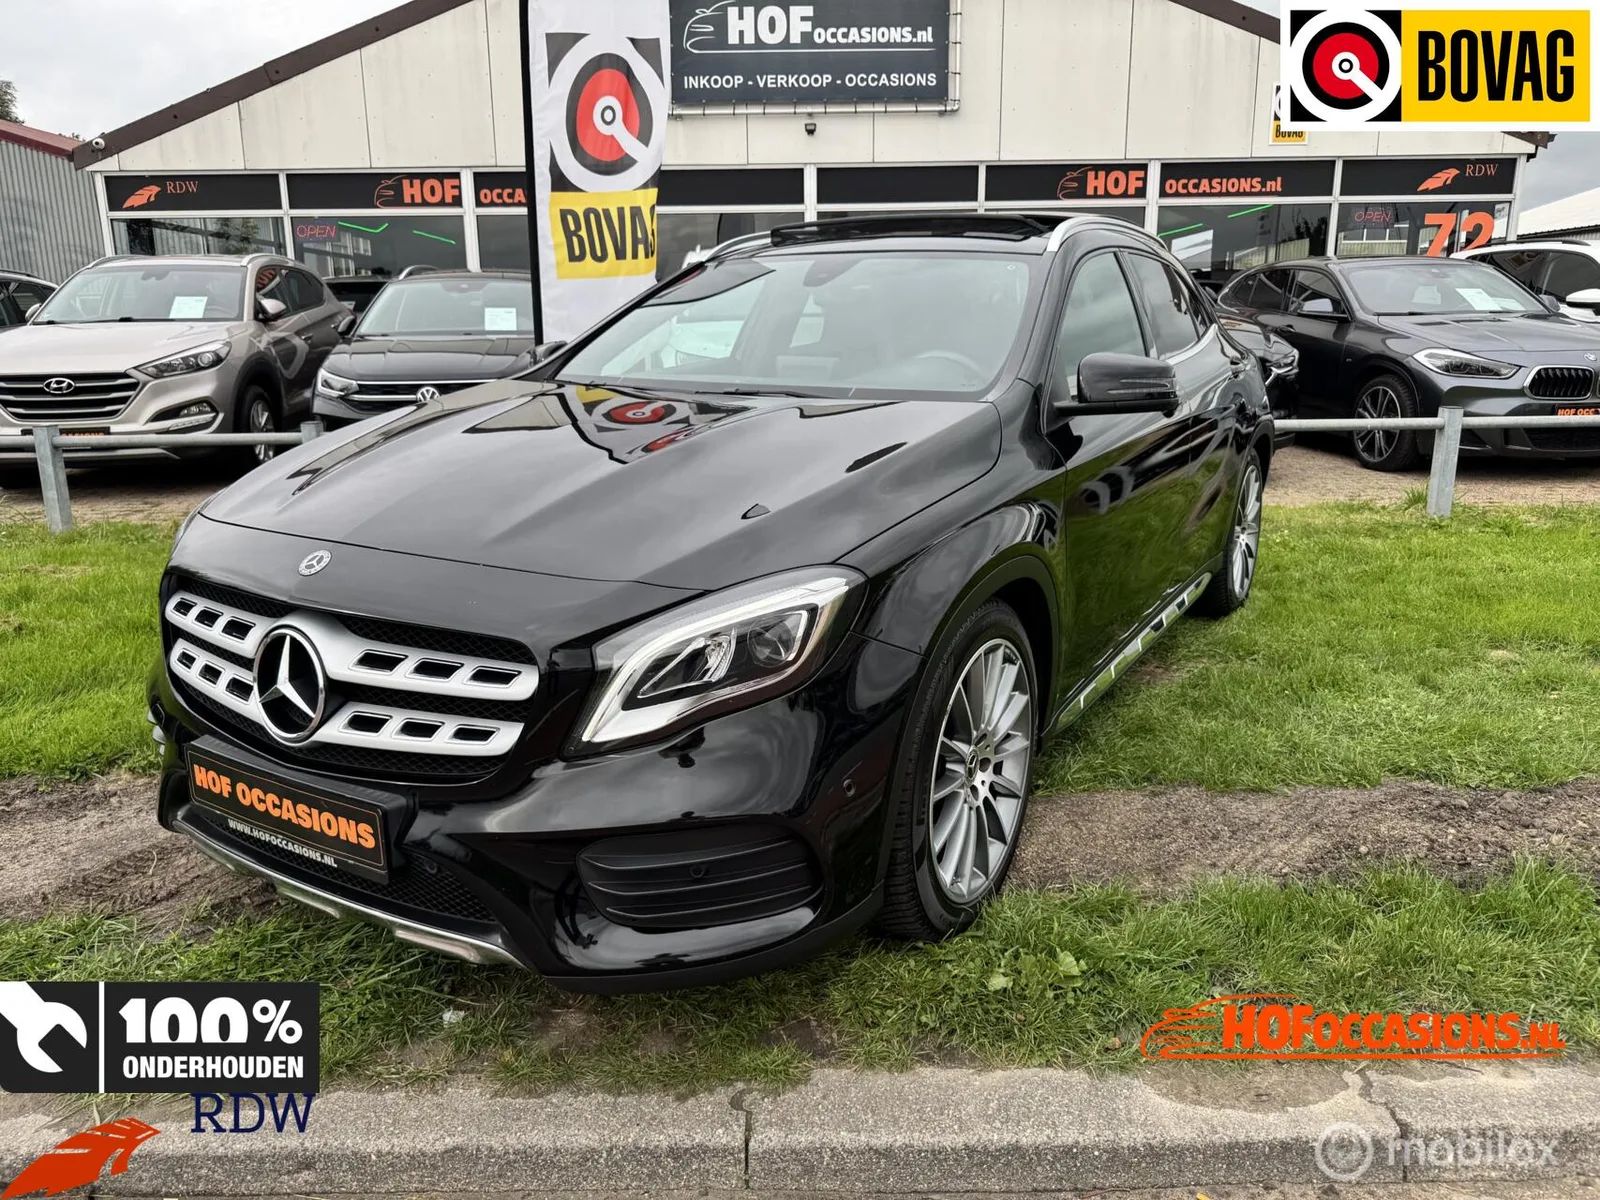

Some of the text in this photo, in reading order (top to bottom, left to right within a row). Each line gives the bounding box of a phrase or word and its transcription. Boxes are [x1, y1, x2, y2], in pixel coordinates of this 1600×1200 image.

[684, 75, 744, 90] INKOOP
[756, 74, 833, 89] VERKOOP
[844, 72, 937, 88] OCCASIONS
[1465, 163, 1499, 177] RDW
[166, 180, 199, 195] RDW
[402, 178, 527, 204] HOF OCCA
[1086, 169, 1283, 196] HOF OCCASIONS.nl
[1353, 211, 1391, 224] OPEN
[296, 224, 337, 238] OPEN
[1424, 211, 1495, 257] 72
[1577, 408, 1597, 416] OCC
[194, 763, 376, 849] HOF OCCASIONS
[227, 818, 338, 868] WWW.HOFOCCASIONS.NL
